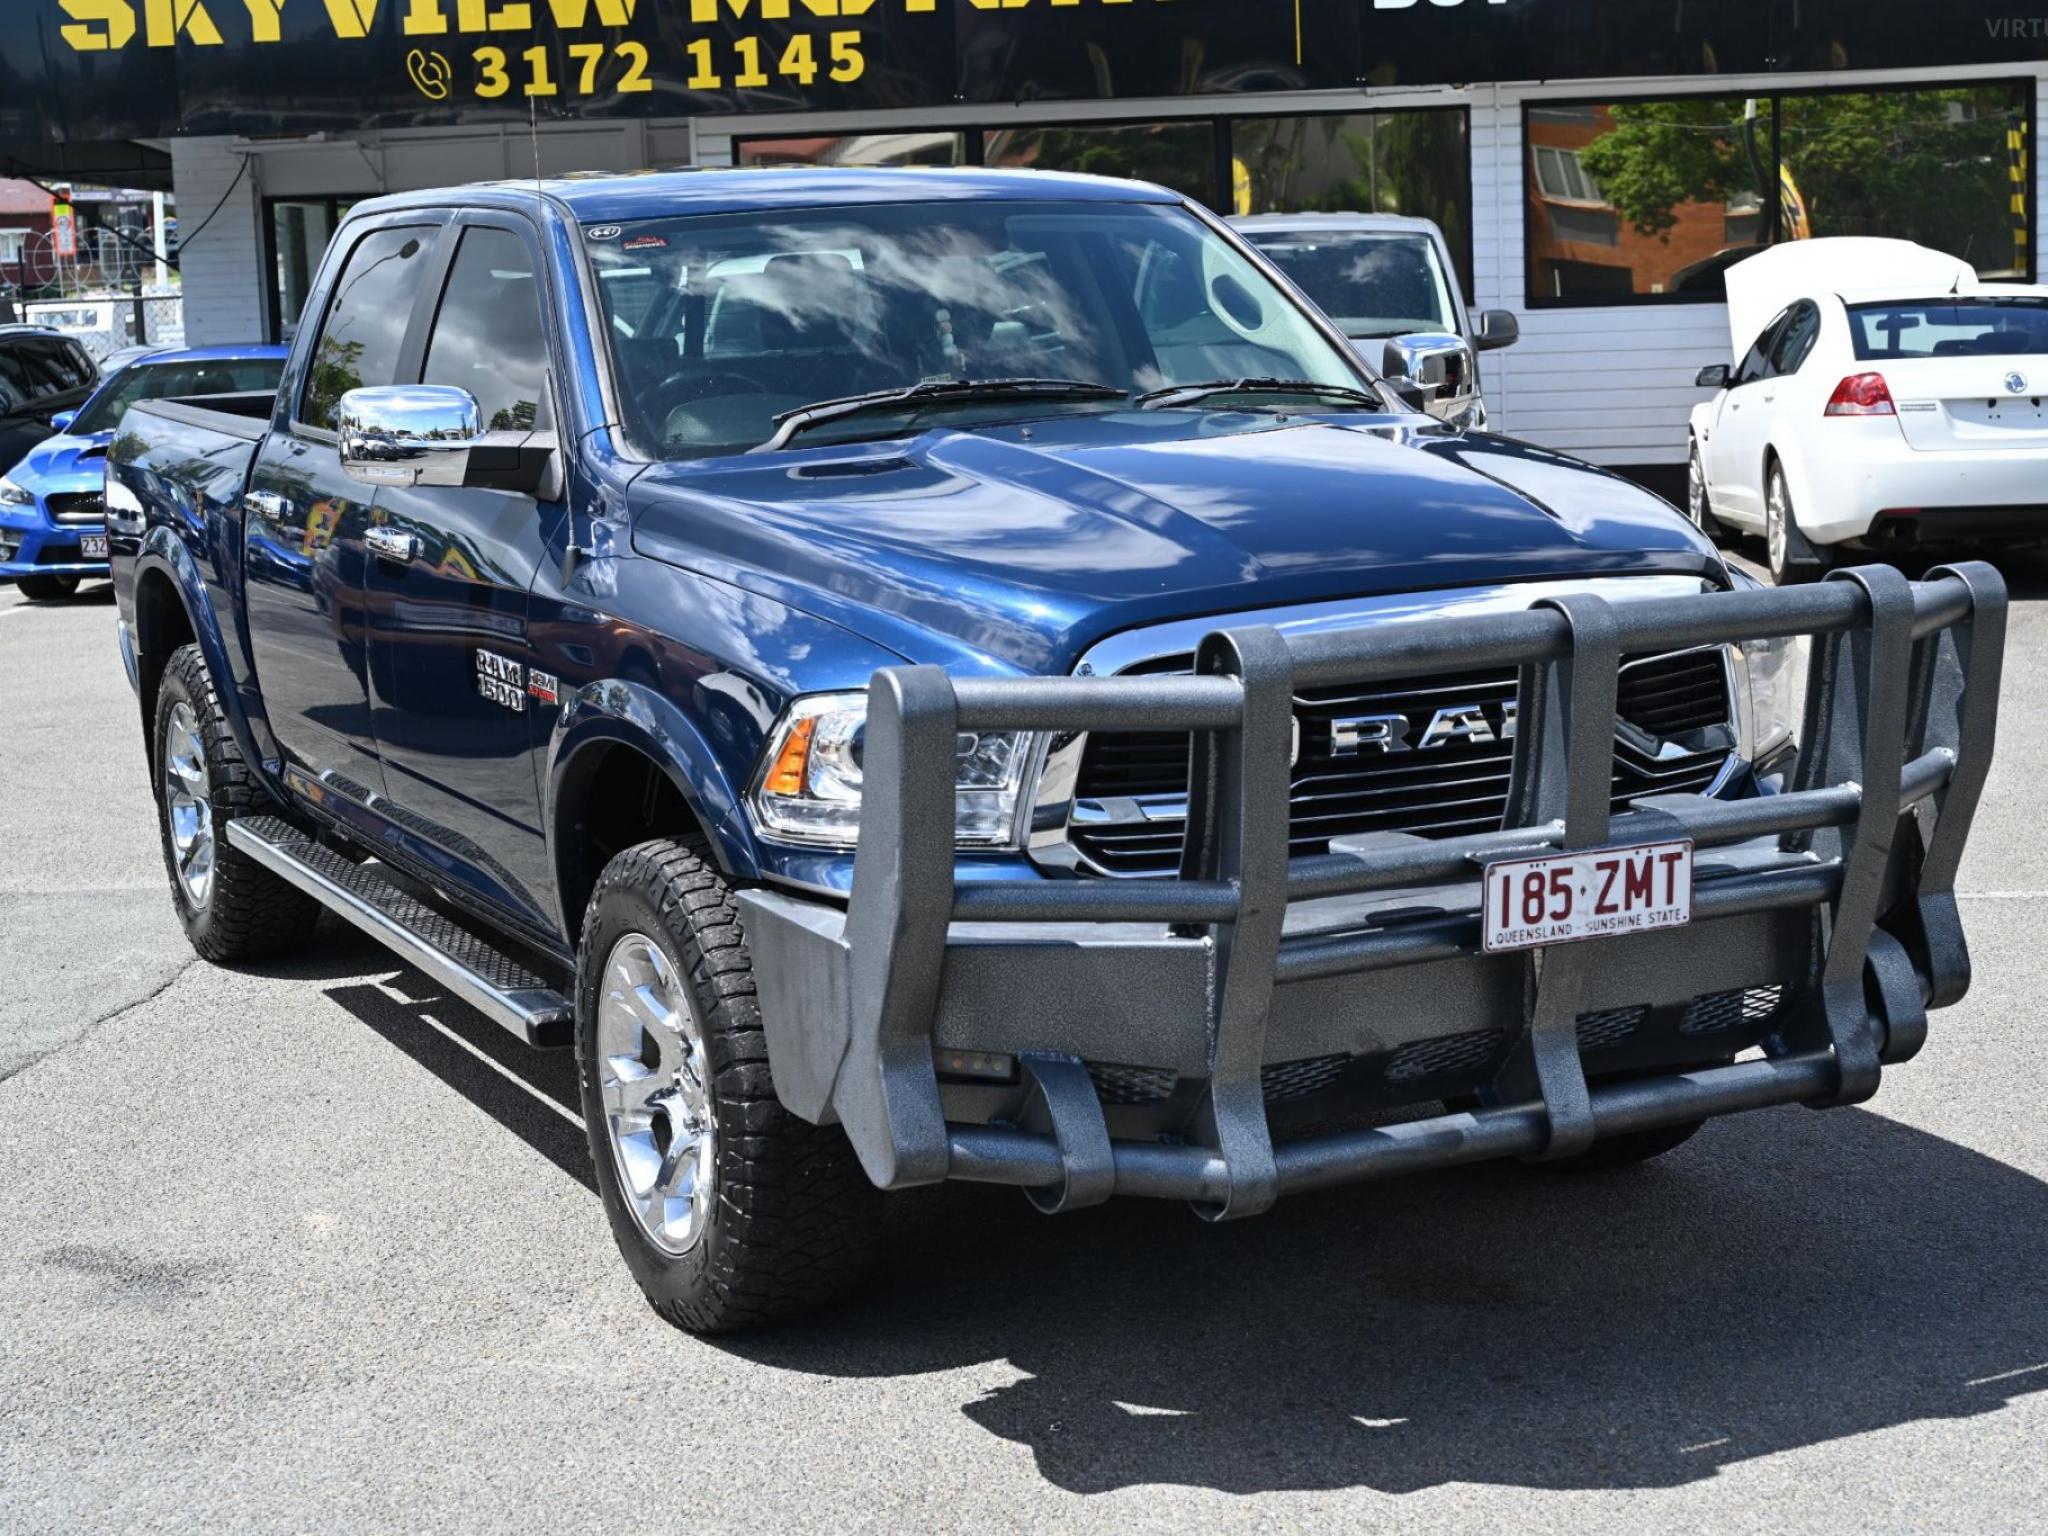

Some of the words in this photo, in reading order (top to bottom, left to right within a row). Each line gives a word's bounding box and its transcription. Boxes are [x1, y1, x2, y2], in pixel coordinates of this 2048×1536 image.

[472, 41, 653, 98] 3172
[687, 30, 865, 90] 1145
[476, 648, 524, 687] RAM
[477, 673, 526, 711] 1500
[1330, 700, 1518, 757] RA
[1496, 923, 1573, 945] QUEENSLAND
[1585, 913, 1642, 933] SUNSHINE
[1649, 908, 1682, 923] STATE
